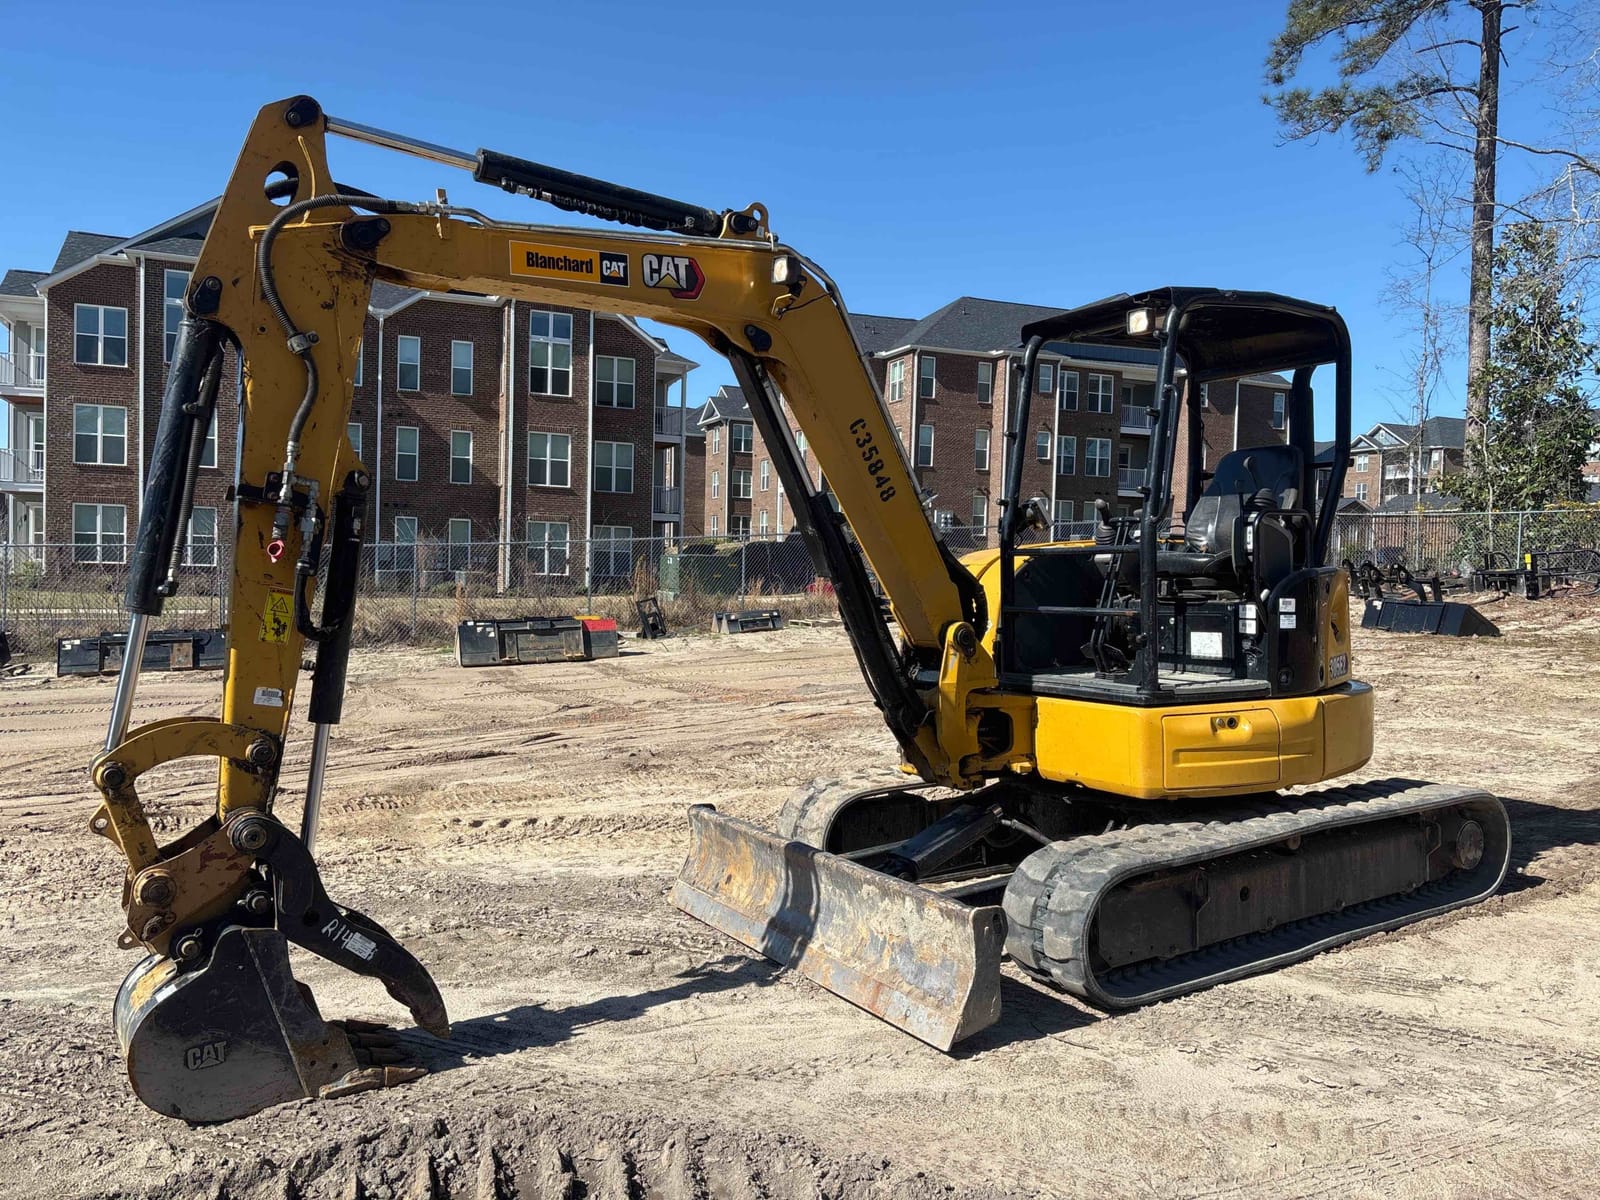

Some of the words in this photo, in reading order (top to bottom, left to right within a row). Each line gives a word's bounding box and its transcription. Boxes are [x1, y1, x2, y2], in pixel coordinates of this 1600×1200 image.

[526, 251, 593, 274] Blanchard
[602, 259, 626, 278] CAT
[643, 254, 689, 289] CAT
[849, 418, 896, 502] C35848
[186, 1041, 227, 1070] CAT
